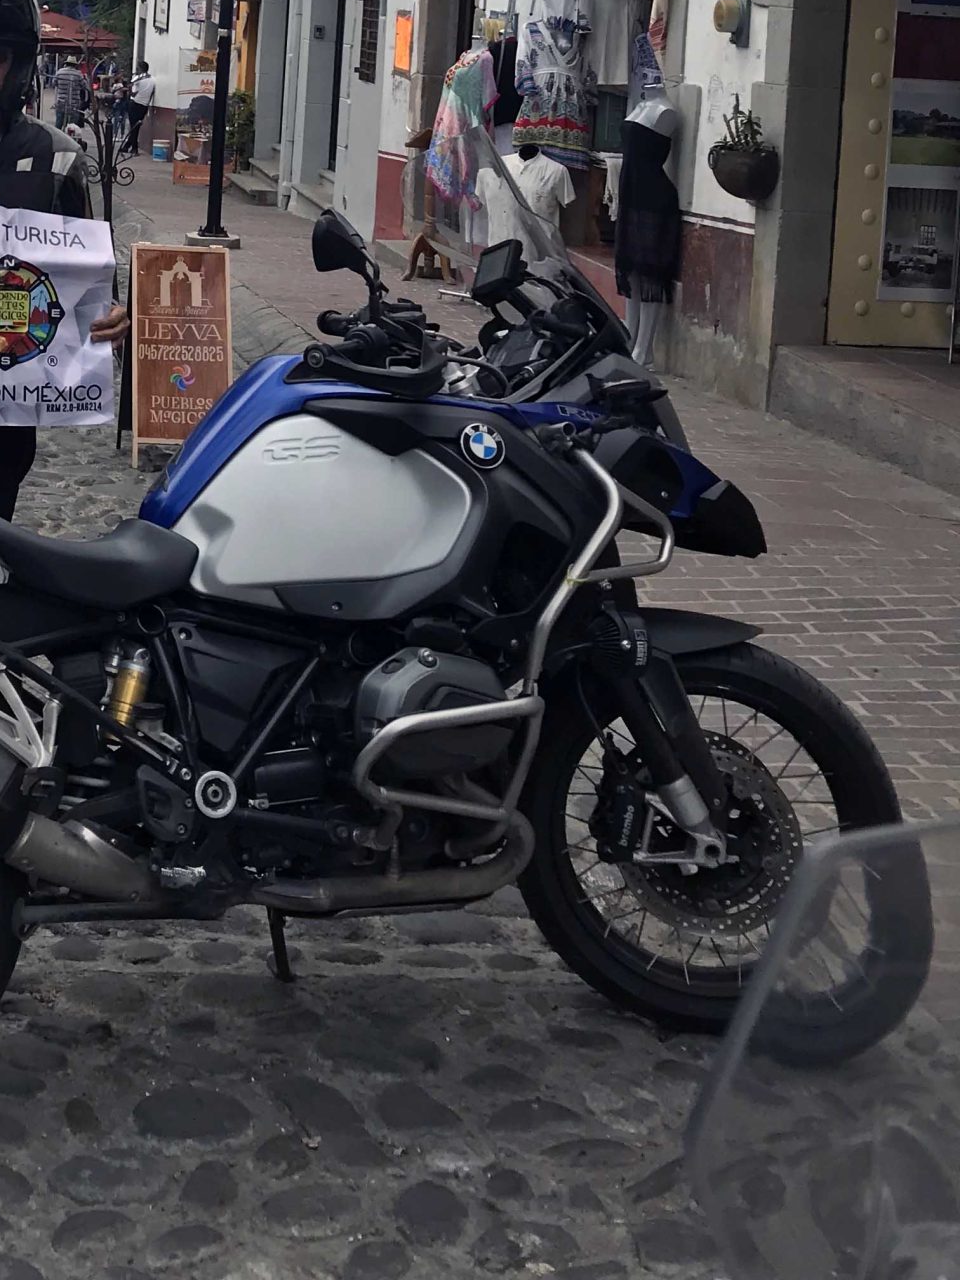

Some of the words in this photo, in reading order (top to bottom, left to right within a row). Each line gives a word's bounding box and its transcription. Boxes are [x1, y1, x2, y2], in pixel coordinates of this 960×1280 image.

[2, 223, 86, 249] TURISTA
[3, 259, 15, 267] N
[51, 309, 60, 317] E
[139, 319, 224, 340] LEYVA
[1, 356, 11, 365] S
[138, 344, 224, 362] 0457222528825
[23, 382, 102, 402] MÉXICO
[46, 404, 61, 413] RRM
[263, 435, 341, 463] GS
[618, 805, 635, 847] brembo
